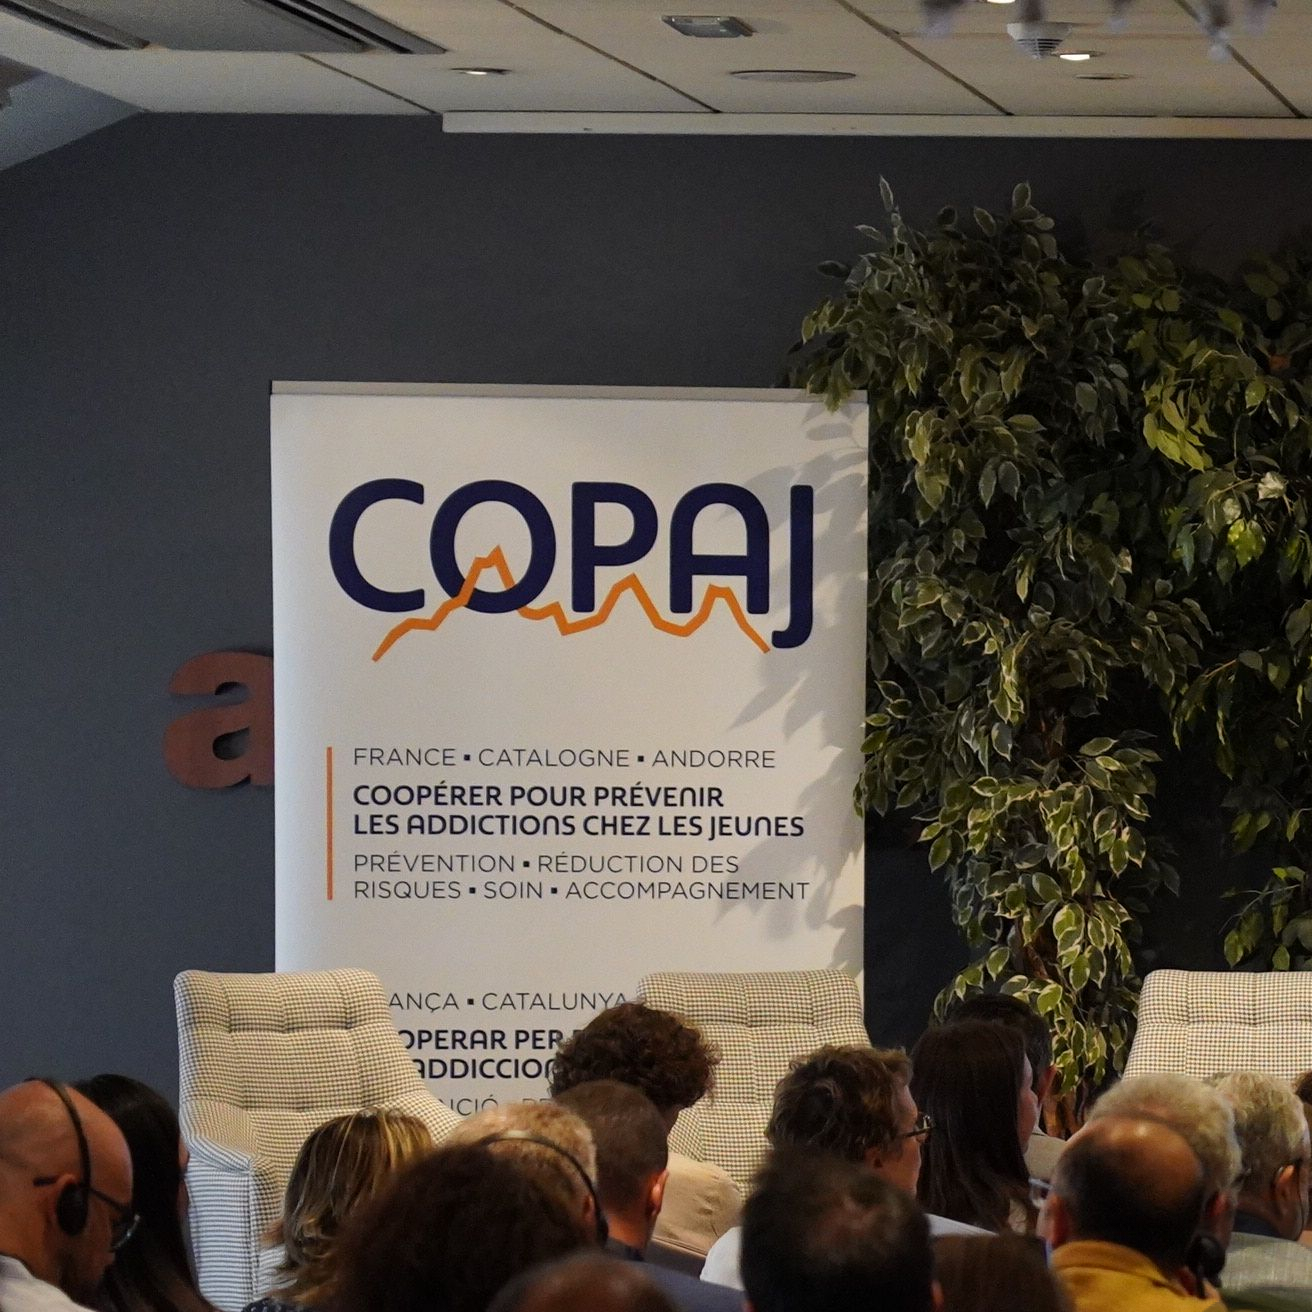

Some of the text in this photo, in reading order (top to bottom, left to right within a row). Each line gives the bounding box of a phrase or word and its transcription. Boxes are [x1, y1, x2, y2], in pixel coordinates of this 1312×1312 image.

[328, 479, 814, 648] COPAJ
[353, 747, 776, 769] FRANCE CATALOGNE ANDORRE
[353, 779, 725, 808] COOPÉRER POUR PRÉVENIR
[354, 814, 805, 842] LES ADDICTIONS CHEZ LES JEUNES
[354, 850, 740, 874] PRÉVENTION RÉDUCTION DES
[354, 880, 810, 900] RISQUES SOIN ACCOMPAGNEMENT
[389, 993, 627, 1013] ANÇA CATALUNYA
[398, 1030, 507, 1049] OPERAR
